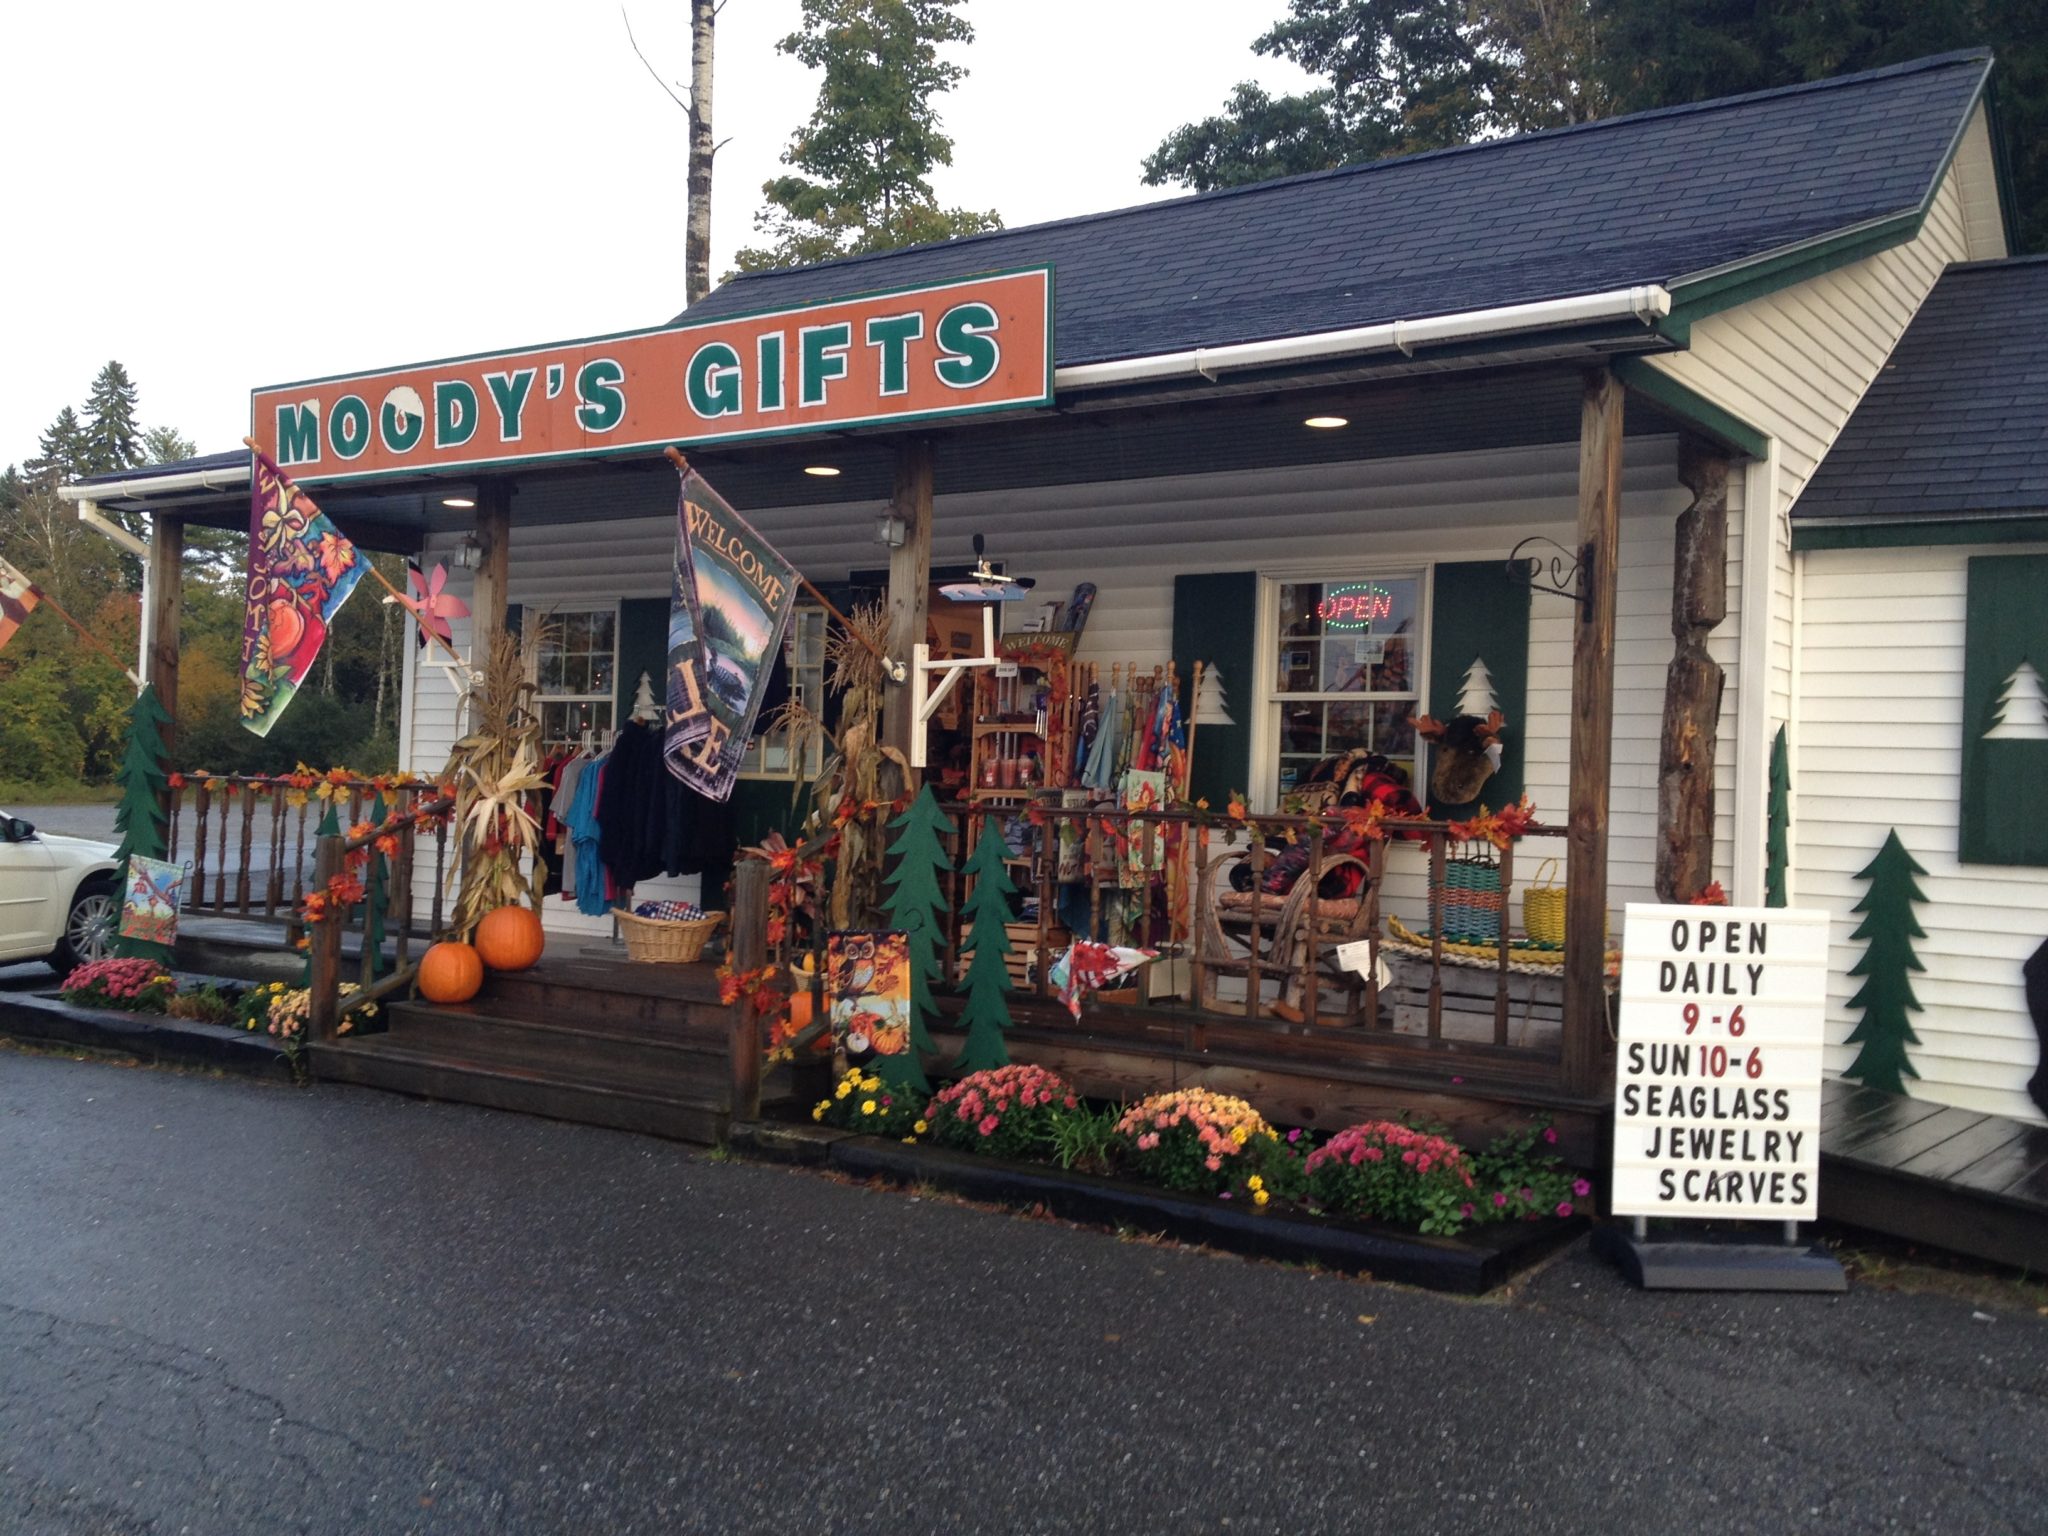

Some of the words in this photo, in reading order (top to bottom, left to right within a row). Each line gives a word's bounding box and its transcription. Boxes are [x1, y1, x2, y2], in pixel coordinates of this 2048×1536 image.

[275, 357, 626, 467] MOODY'S
[684, 301, 1001, 420] GIFTS
[684, 500, 786, 612] WELCOME
[1317, 594, 1392, 619] OPEN
[1006, 634, 1069, 651] WELCOME
[1671, 919, 1768, 955] OPEN
[1659, 960, 1764, 996] DAILY
[1627, 1042, 1690, 1076] SUN
[1700, 1045, 1764, 1079] 10-6
[1623, 1083, 1789, 1121] SEAGLASS
[1645, 1126, 1803, 1164] JEWELRY
[1658, 1168, 1808, 1205] SCARVES
